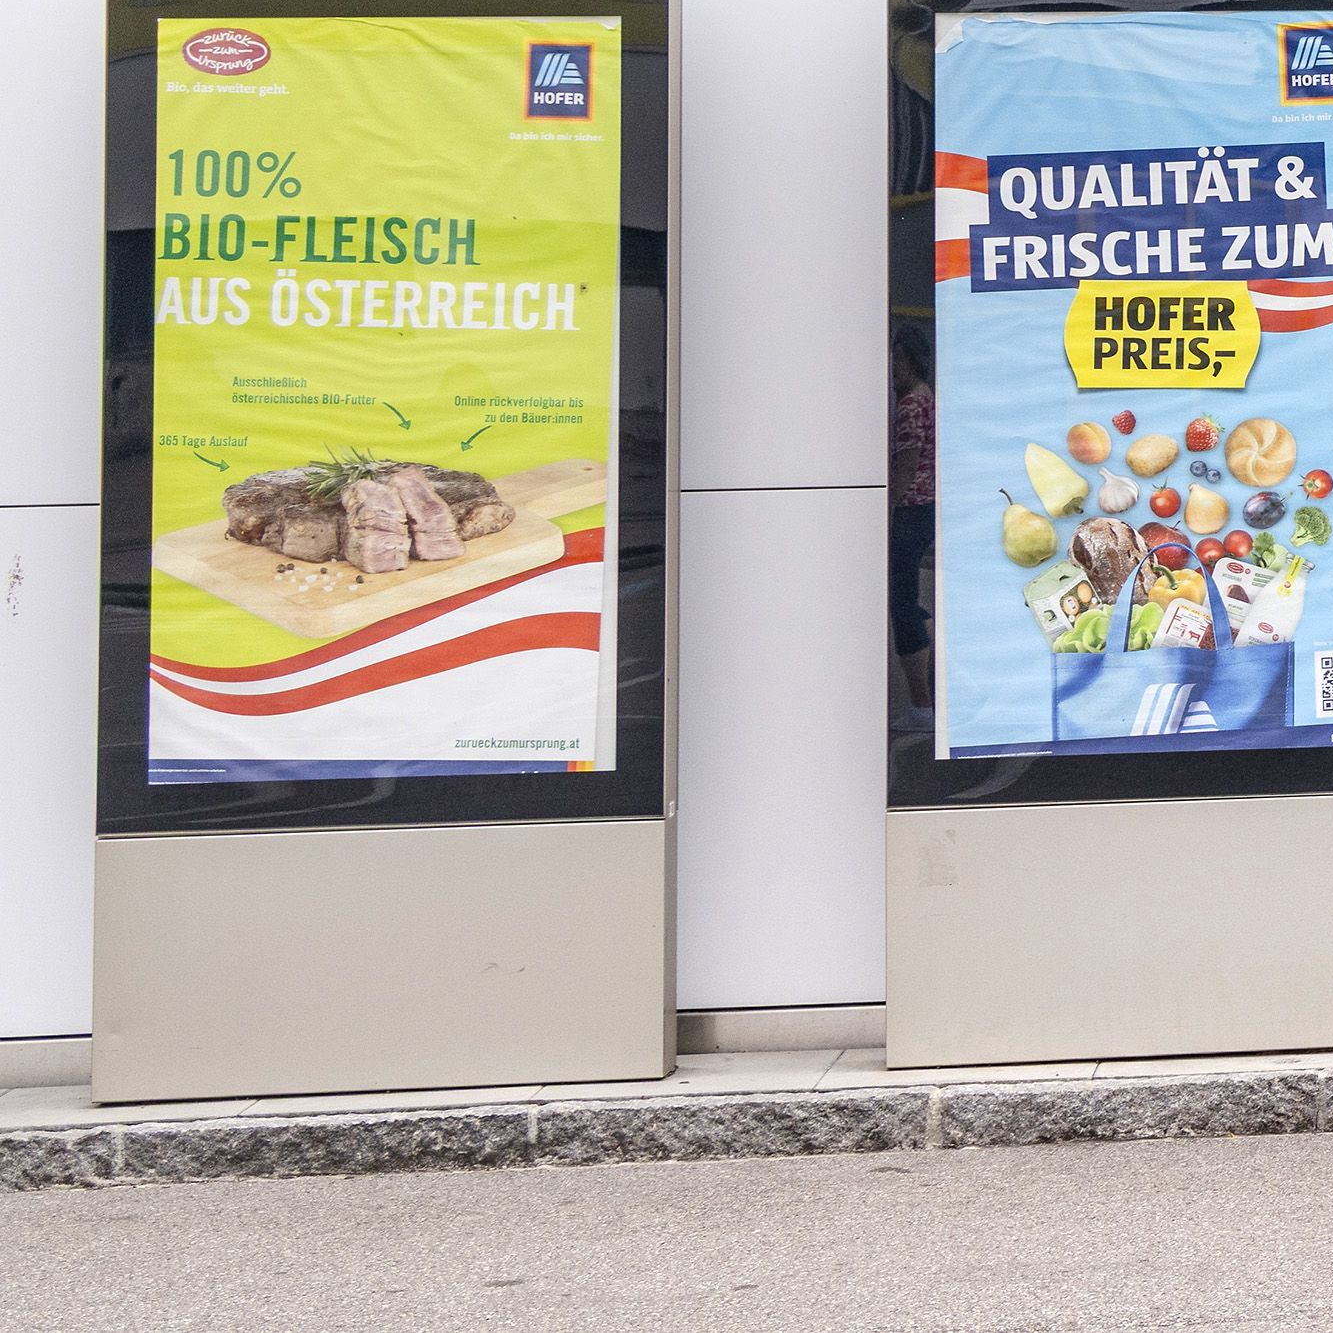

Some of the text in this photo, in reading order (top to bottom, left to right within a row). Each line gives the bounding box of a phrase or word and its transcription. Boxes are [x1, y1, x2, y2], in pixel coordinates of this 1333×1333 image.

[203, 30, 251, 47] zurück
[212, 46, 239, 55] zum
[166, 81, 289, 97] Bio, das weiter geht.
[533, 92, 584, 104] HOFER
[1271, 115, 1283, 123] Da
[1285, 115, 1299, 123] bin
[1301, 113, 1315, 122] ich
[1317, 112, 1331, 121] mir
[168, 149, 301, 199] 100%
[1000, 146, 1318, 220] QUALITÄT &
[158, 213, 480, 266] BIO-FLEISCH
[983, 227, 1206, 281] FRISCHE
[155, 269, 580, 331] AUS ÖSTERREICH
[1093, 296, 1236, 333] HOFER
[1093, 336, 1236, 378] PREIS,-
[232, 376, 307, 388] Ausschließlich
[232, 393, 377, 405] österreichisches BIO-Futter
[454, 395, 584, 410] Online rückverfolgbar bis
[485, 413, 583, 424] zu den Bäuer:innen
[159, 435, 248, 449] 365 Tage Auslauf
[455, 737, 580, 751] zurueckzumursprung.at
